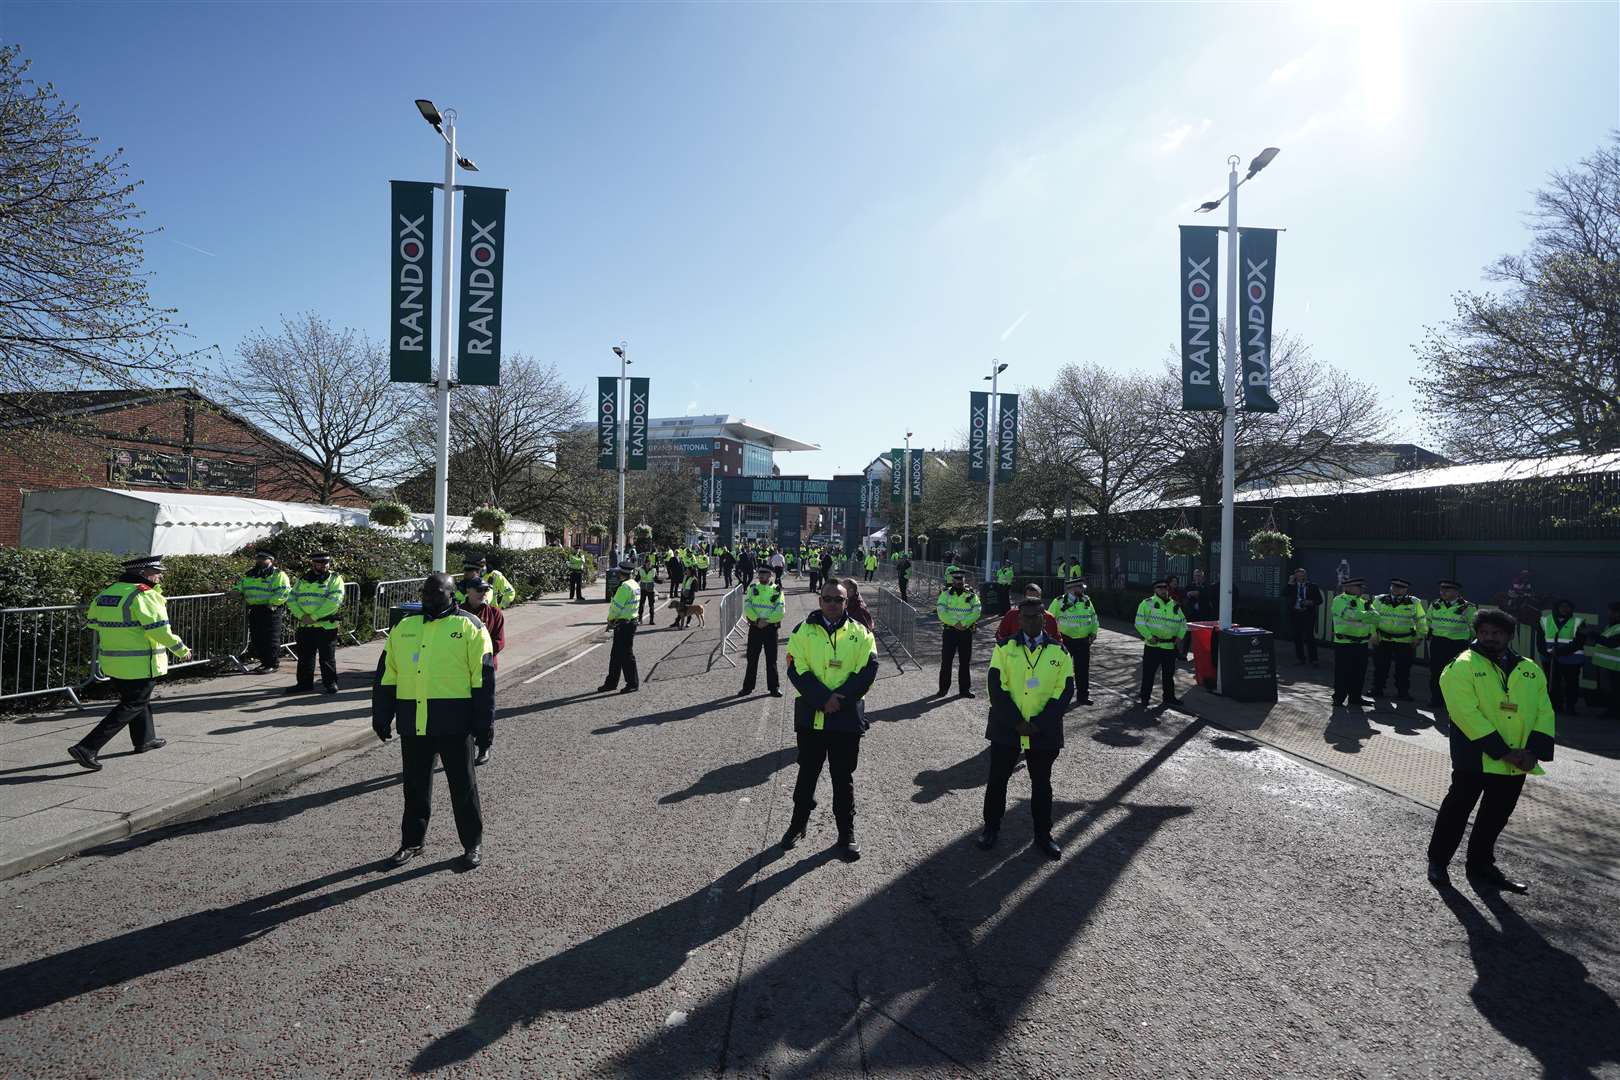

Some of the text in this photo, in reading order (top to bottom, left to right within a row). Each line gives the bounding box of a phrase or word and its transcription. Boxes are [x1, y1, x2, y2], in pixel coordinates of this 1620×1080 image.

[400, 214, 424, 351] RANDOX
[467, 218, 496, 355] RANDOX
[1188, 257, 1211, 385] RANDOX
[1247, 258, 1271, 386] RANDOX
[602, 391, 614, 456] RANDOX
[632, 392, 646, 456] RANDOX
[673, 443, 708, 452] NATIONAL
[972, 406, 985, 469] RANDOX
[1001, 407, 1015, 470] RANDOX
[893, 456, 902, 496] RANDOX
[913, 457, 921, 496] RANDOX
